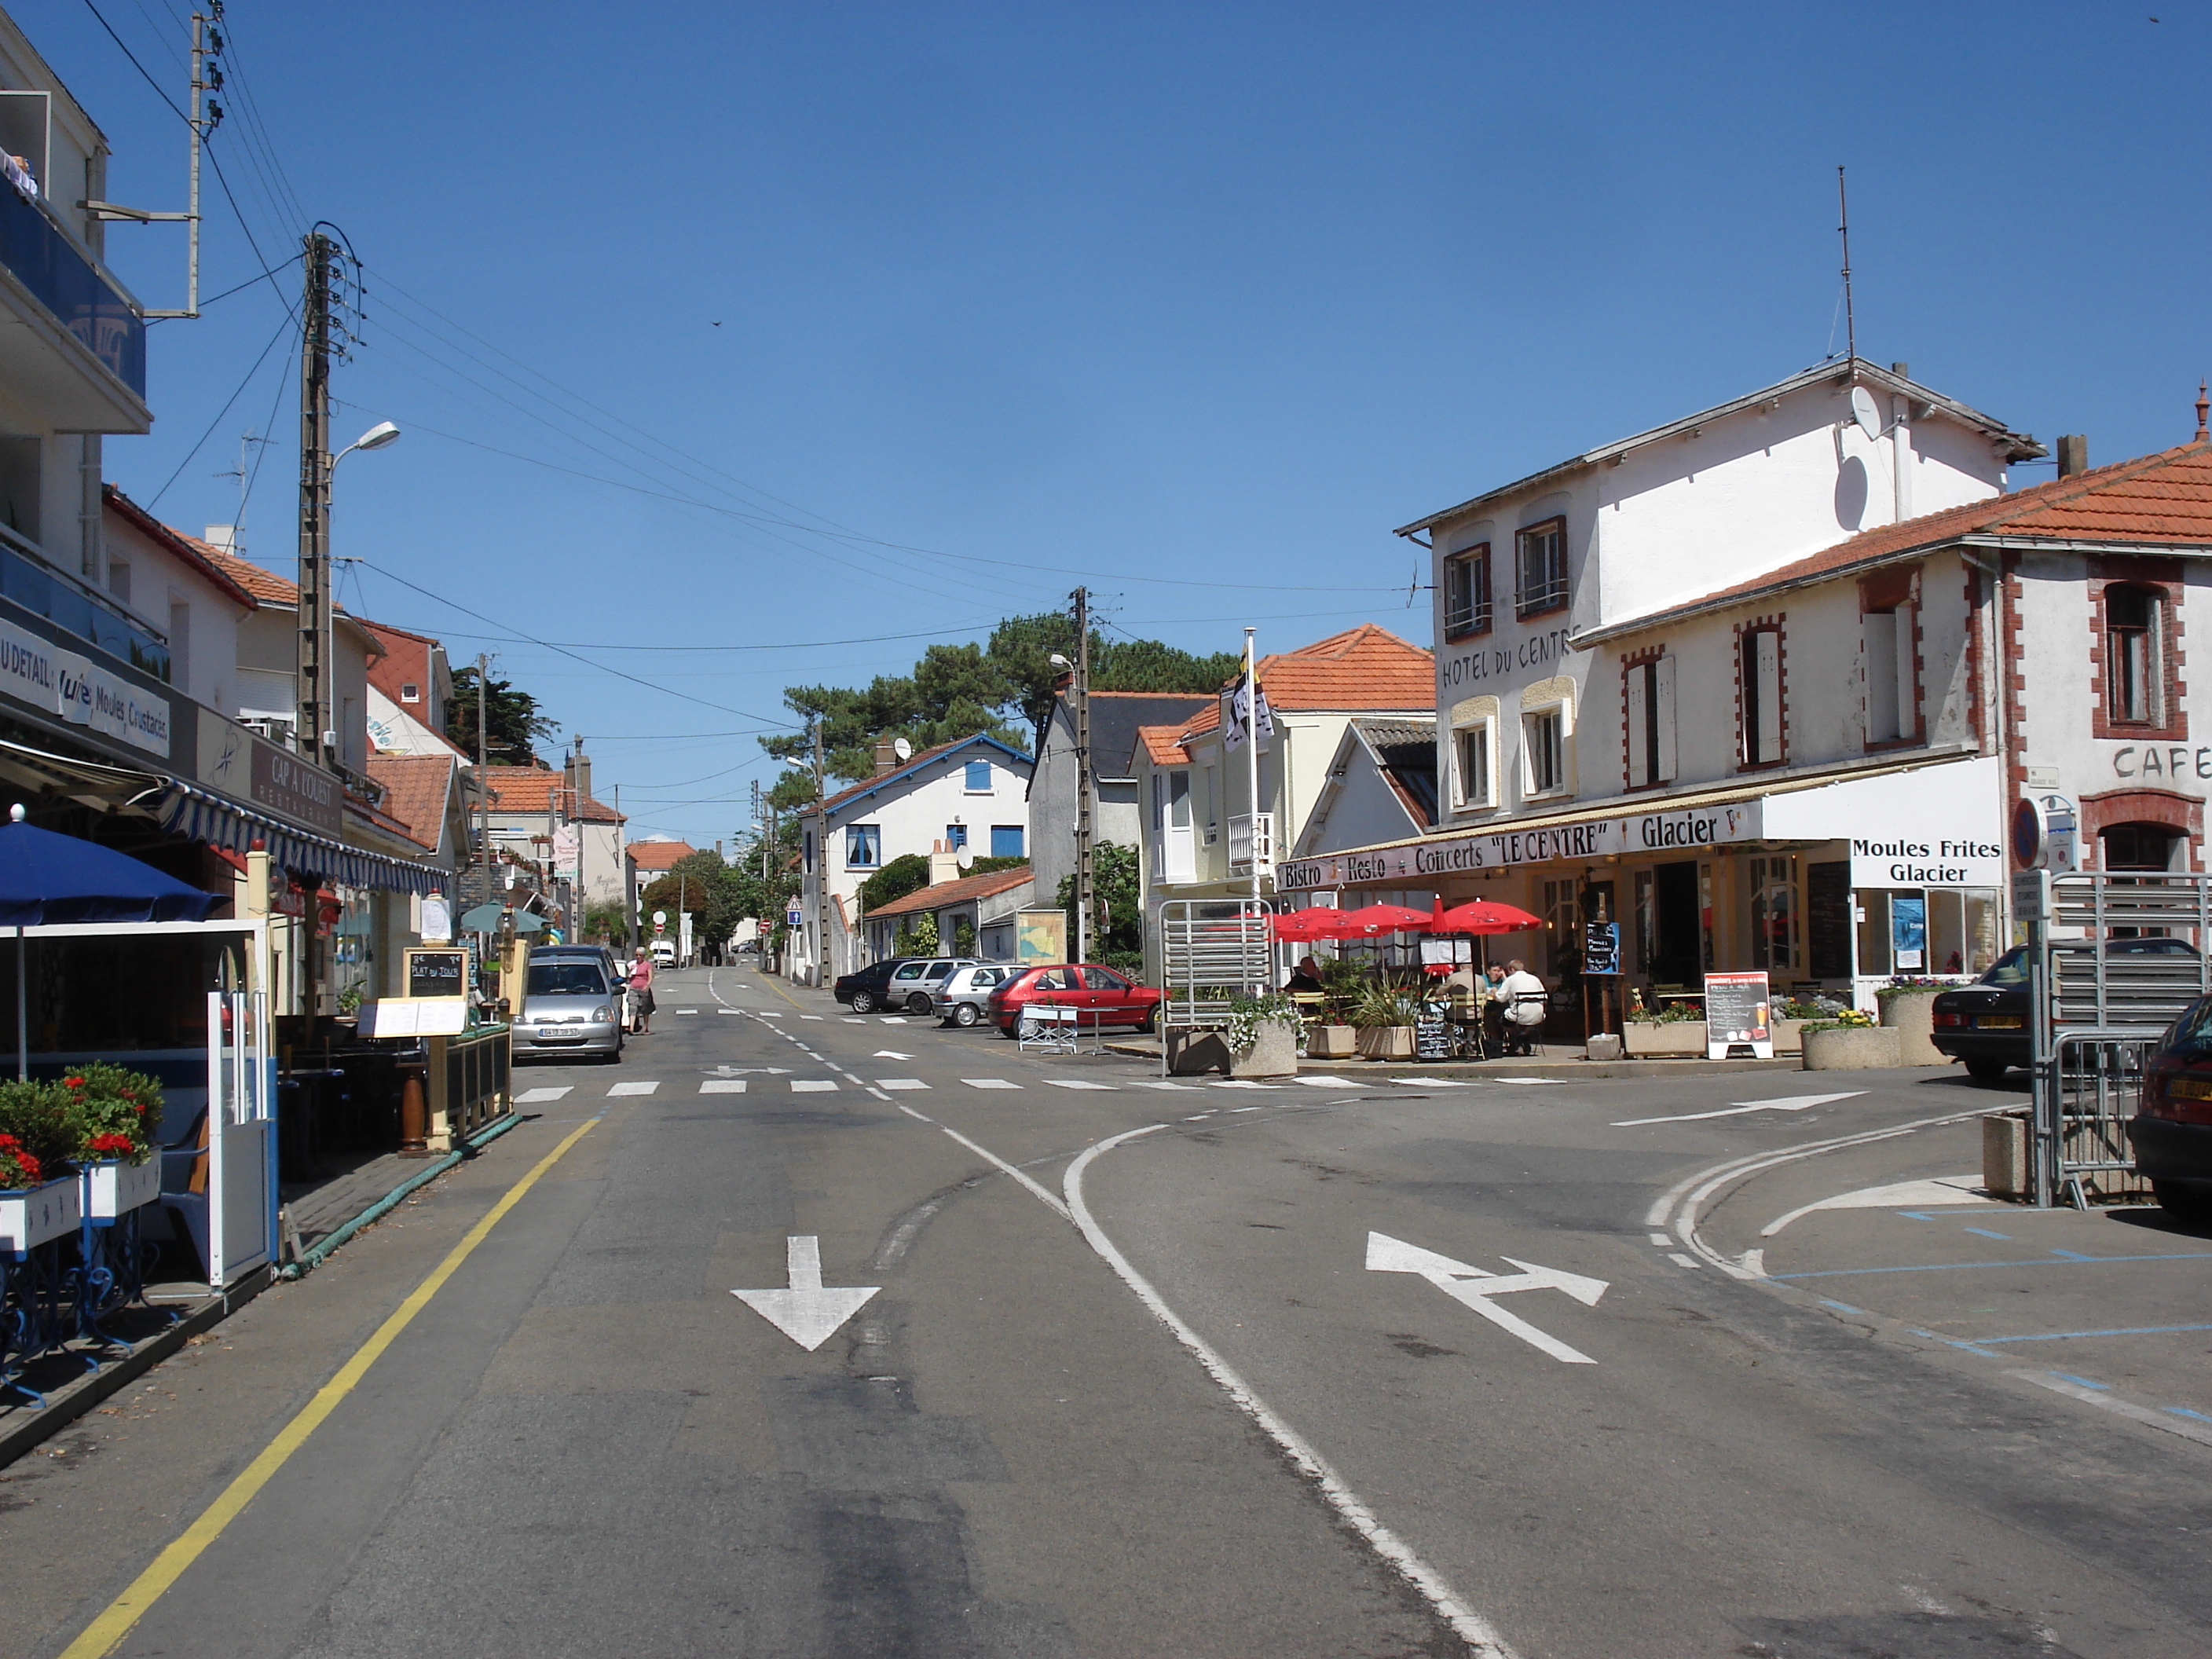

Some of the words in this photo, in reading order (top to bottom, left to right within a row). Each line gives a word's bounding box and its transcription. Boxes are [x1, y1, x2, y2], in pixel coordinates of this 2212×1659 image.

[1443, 650, 1488, 688] HOTEL
[1495, 650, 1511, 674] DU
[272, 756, 290, 786] CAP
[291, 766, 298, 793] A
[302, 771, 331, 807] L'OUEST
[1286, 864, 1320, 888] Bistro
[1347, 855, 1386, 881] Resto
[1415, 842, 1483, 873] Concerts
[1642, 811, 1716, 848] Glacier
[1853, 840, 1930, 857] Moules
[1940, 840, 2001, 858] Frites
[1890, 864, 1968, 881] Glacier
[412, 965, 429, 974] PLAT
[438, 966, 460, 976] JOUR
